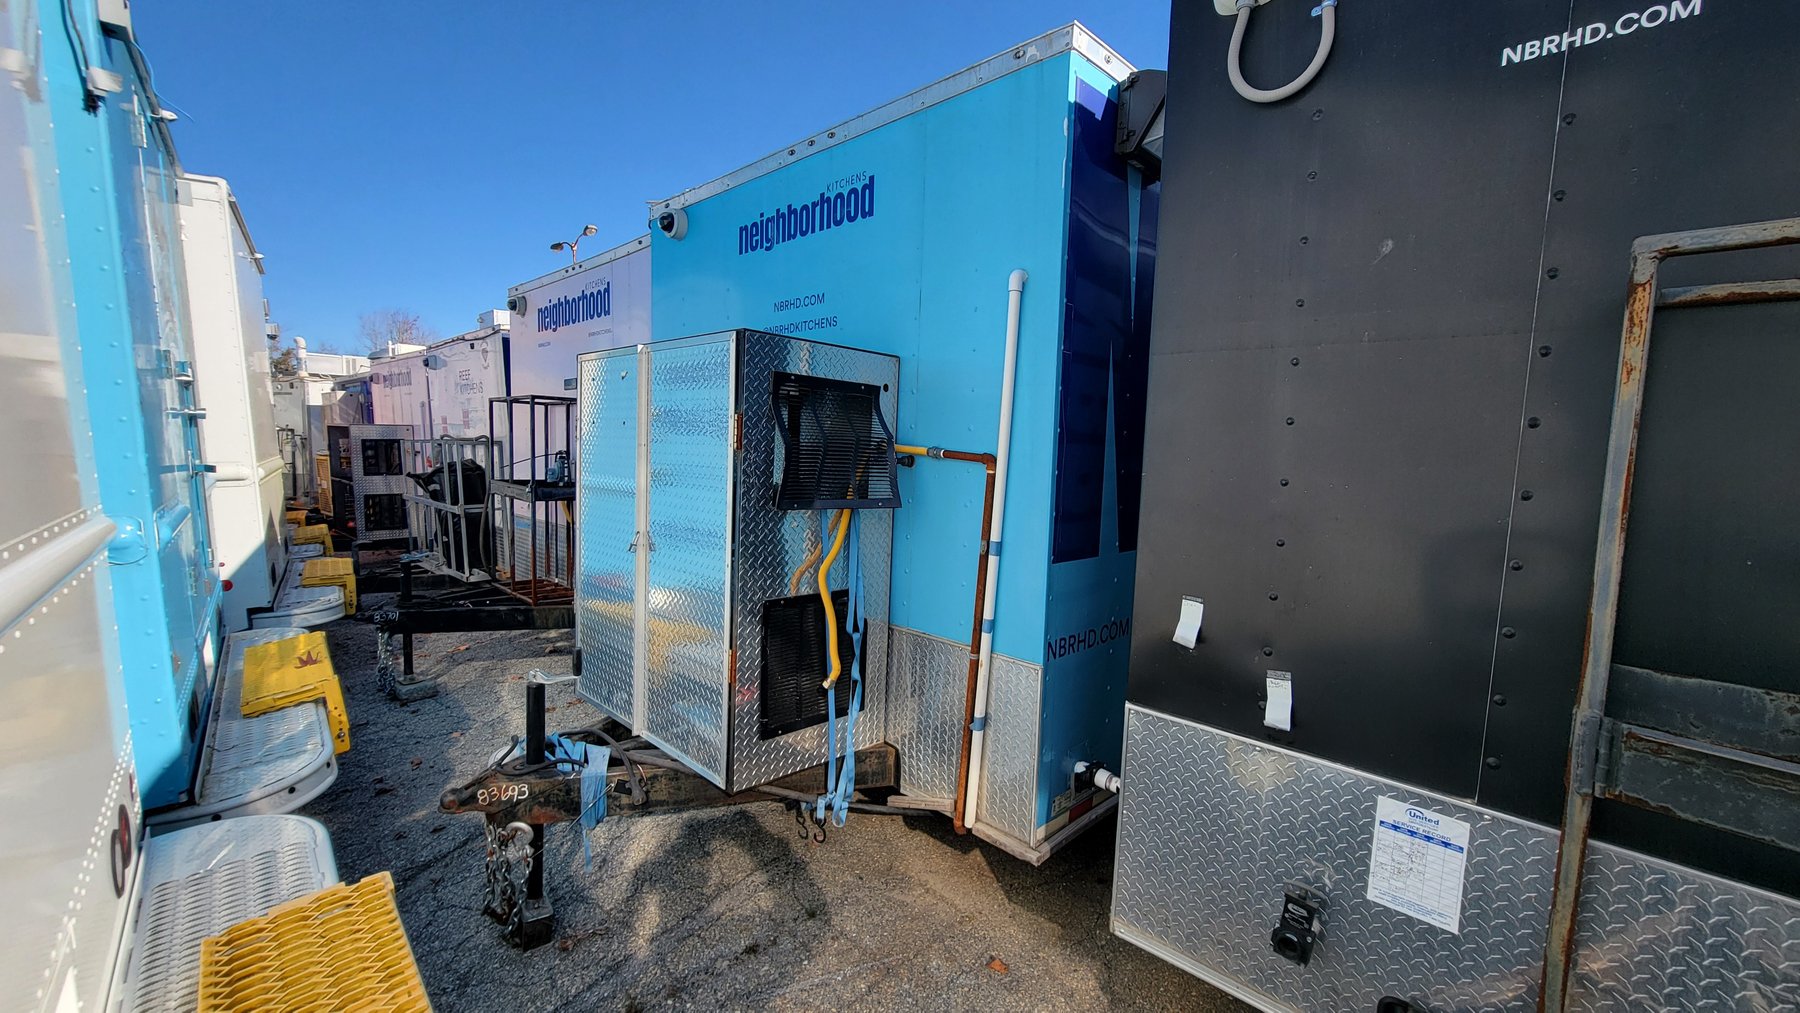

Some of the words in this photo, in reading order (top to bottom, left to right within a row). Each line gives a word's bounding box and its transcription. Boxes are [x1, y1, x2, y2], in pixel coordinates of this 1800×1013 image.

[1501, 0, 1701, 67] NBRHD.COM
[826, 171, 867, 193] KITCHENS
[738, 174, 875, 256] neighborhood
[585, 276, 607, 290] KITCHENS
[537, 281, 611, 332] neighborhood
[773, 292, 825, 313] NBRHD.COM
[373, 610, 399, 623] 83701
[1046, 617, 1130, 663] NBRHD.COM
[477, 783, 529, 806] 83693
[1407, 809, 1440, 826] United
[1392, 819, 1420, 832] SERVICE
[1421, 828, 1452, 841] RECORD
